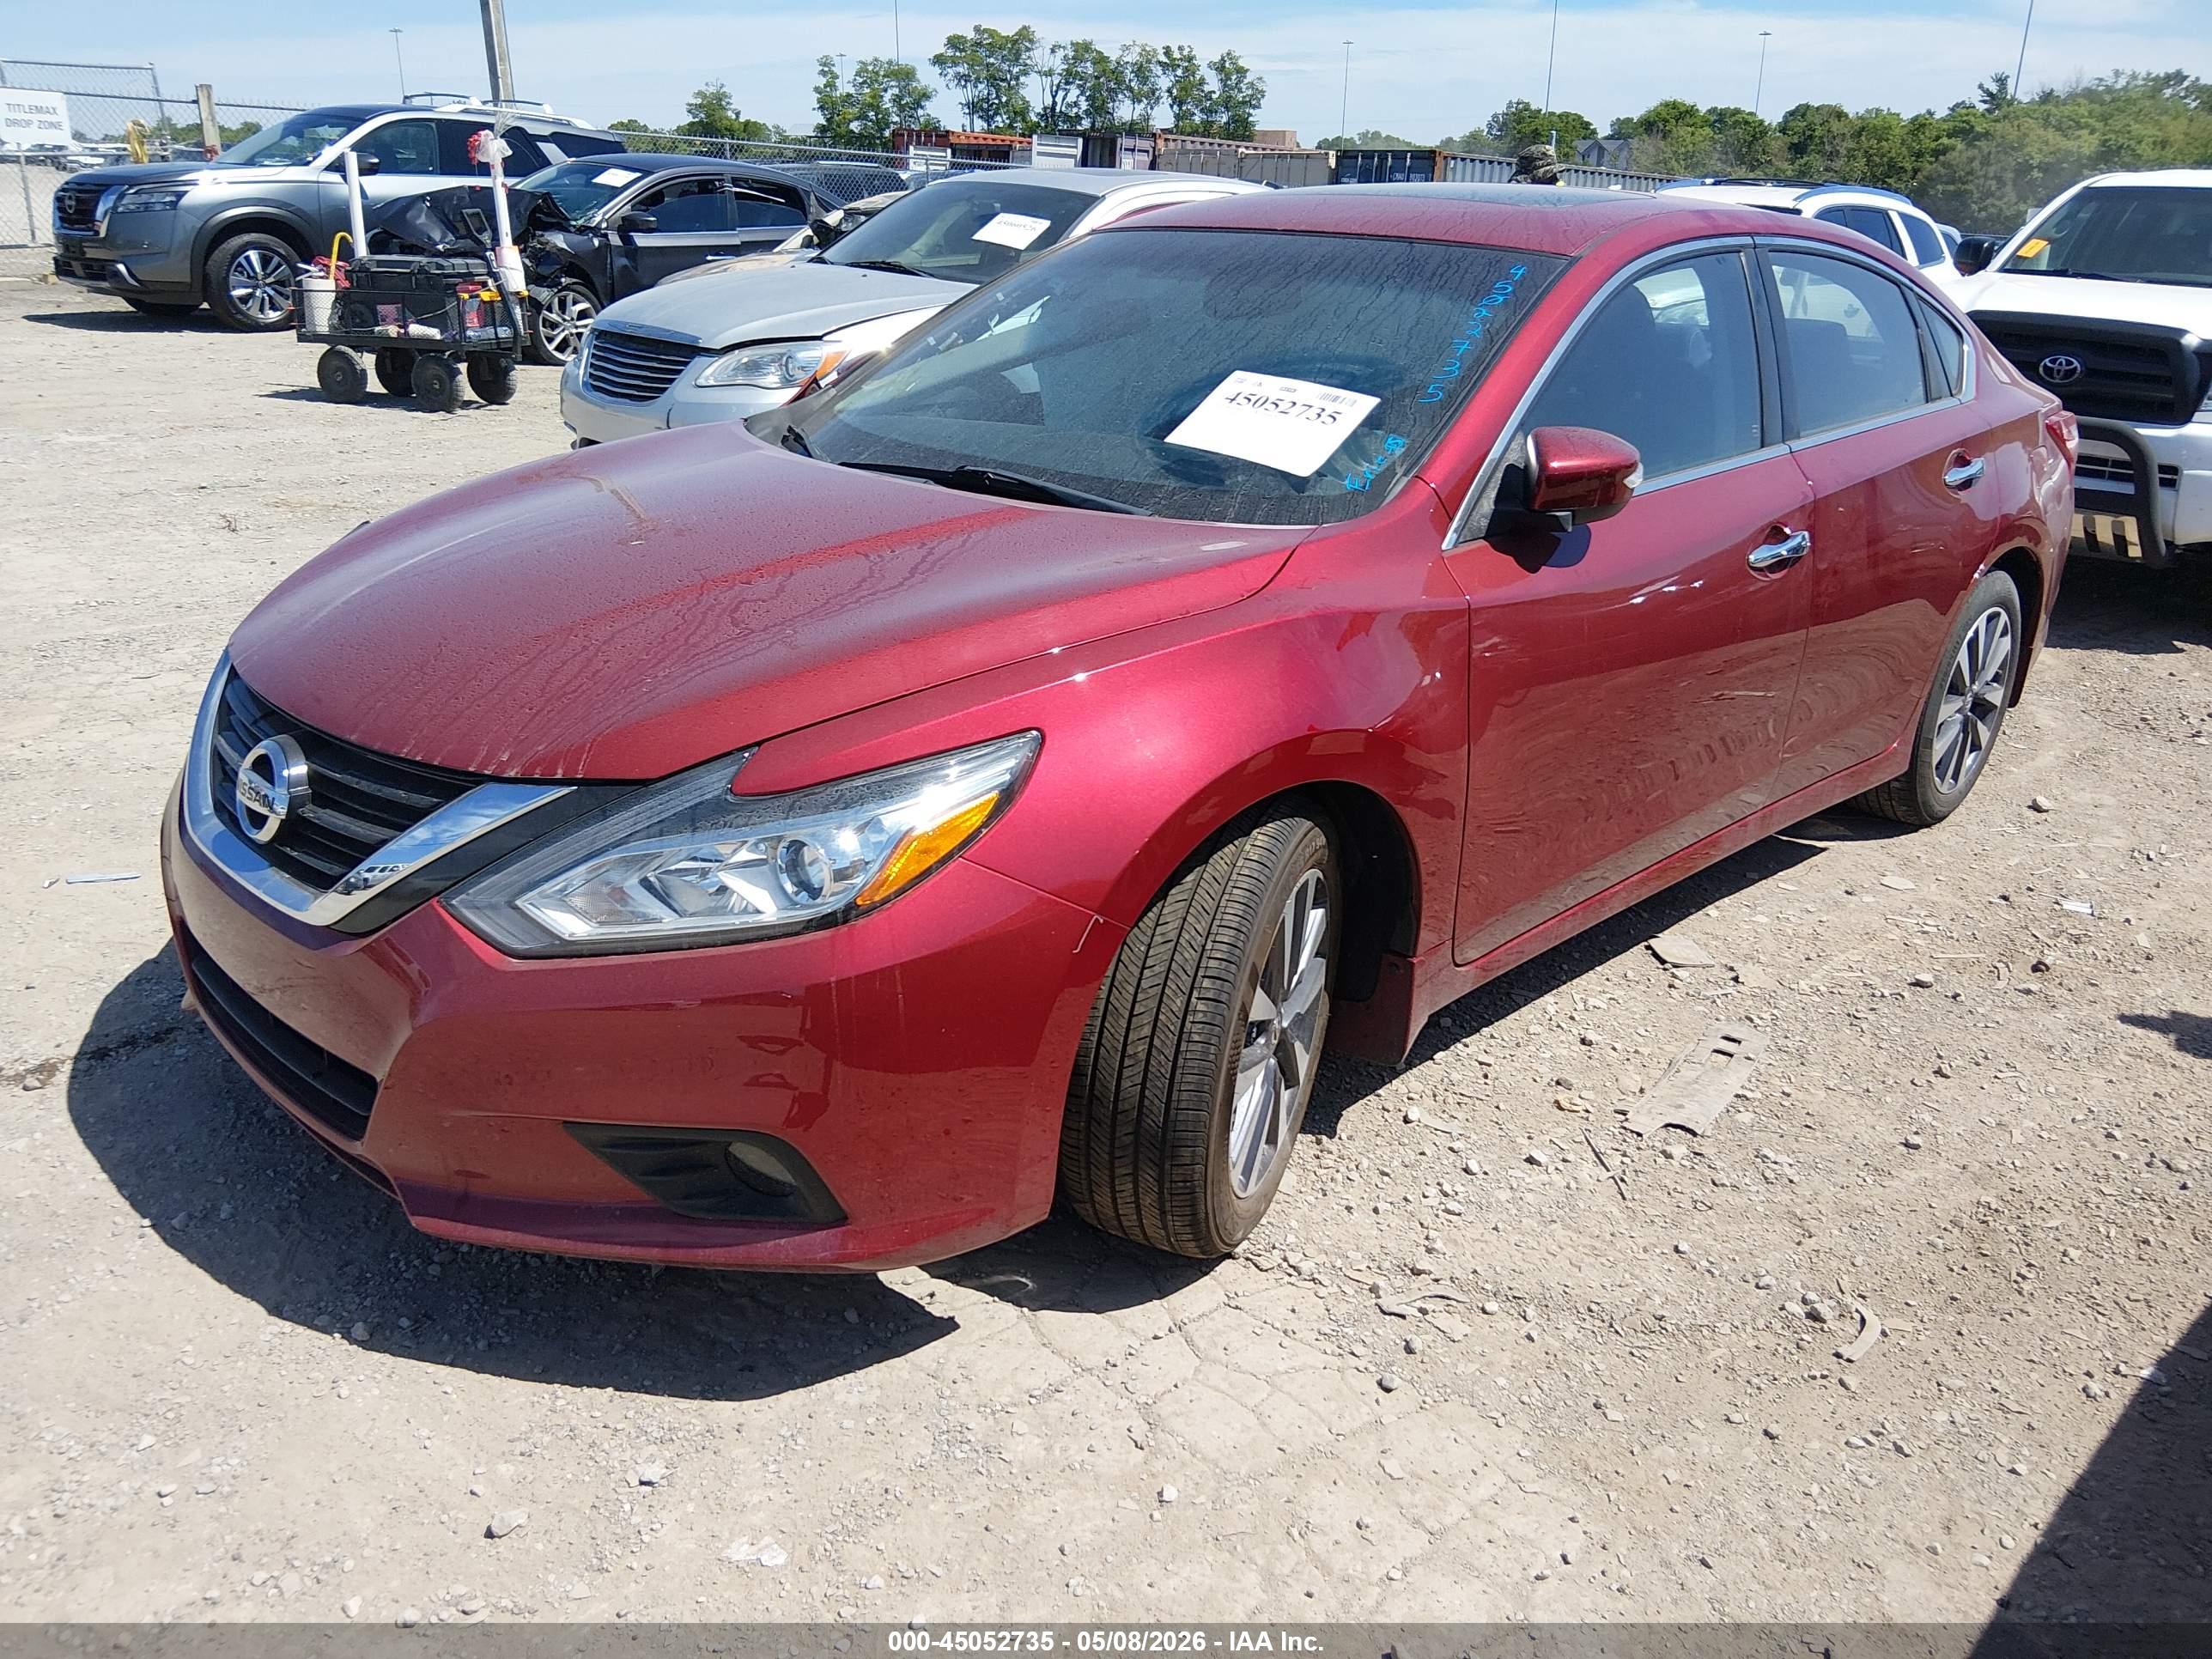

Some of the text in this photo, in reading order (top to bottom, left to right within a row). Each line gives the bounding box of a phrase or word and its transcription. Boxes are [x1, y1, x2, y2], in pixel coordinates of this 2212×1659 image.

[5, 103, 58, 116] TITLEMAX
[5, 118, 64, 131] DROP ZONE
[1224, 391, 1342, 425] 45052735
